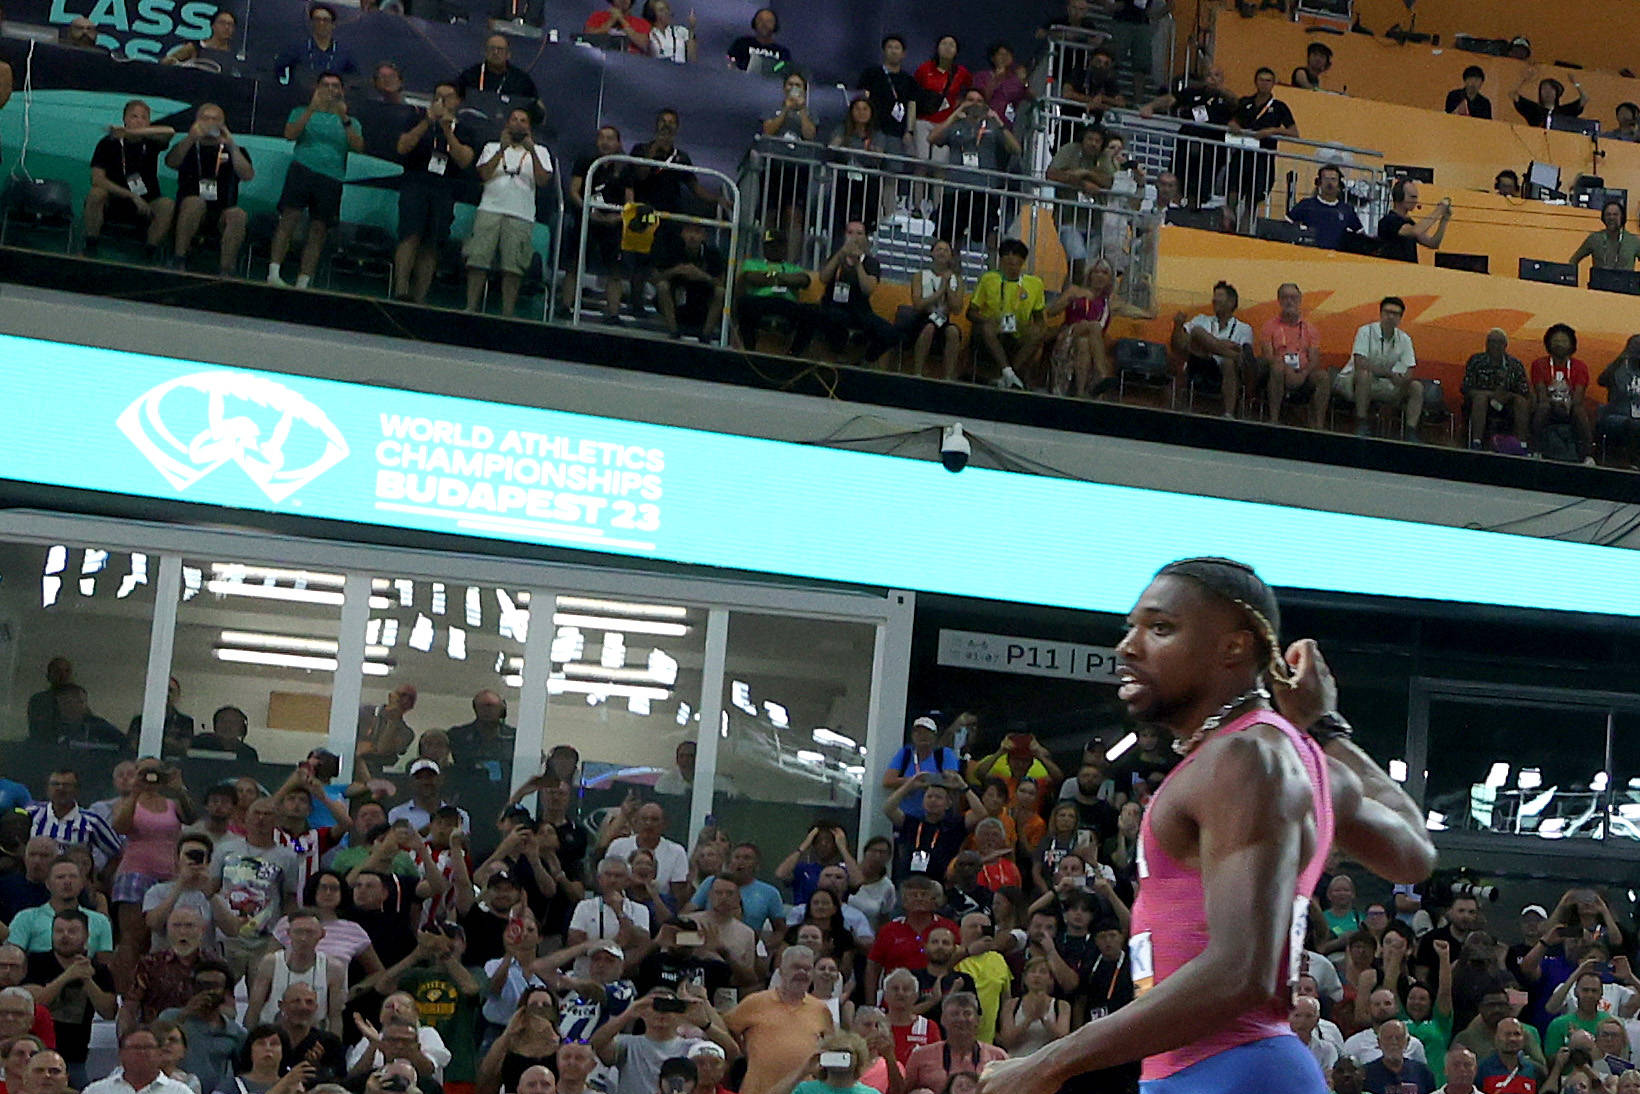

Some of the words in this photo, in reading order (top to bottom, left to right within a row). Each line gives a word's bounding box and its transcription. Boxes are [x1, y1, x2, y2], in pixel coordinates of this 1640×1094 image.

[375, 440, 663, 501] CHAMPIONSHIPS
[379, 413, 495, 449] WORLD
[499, 430, 665, 472] ATHLETICS
[375, 470, 608, 524] BUDAPEST
[611, 499, 661, 532] 23
[1006, 644, 1060, 670] P11
